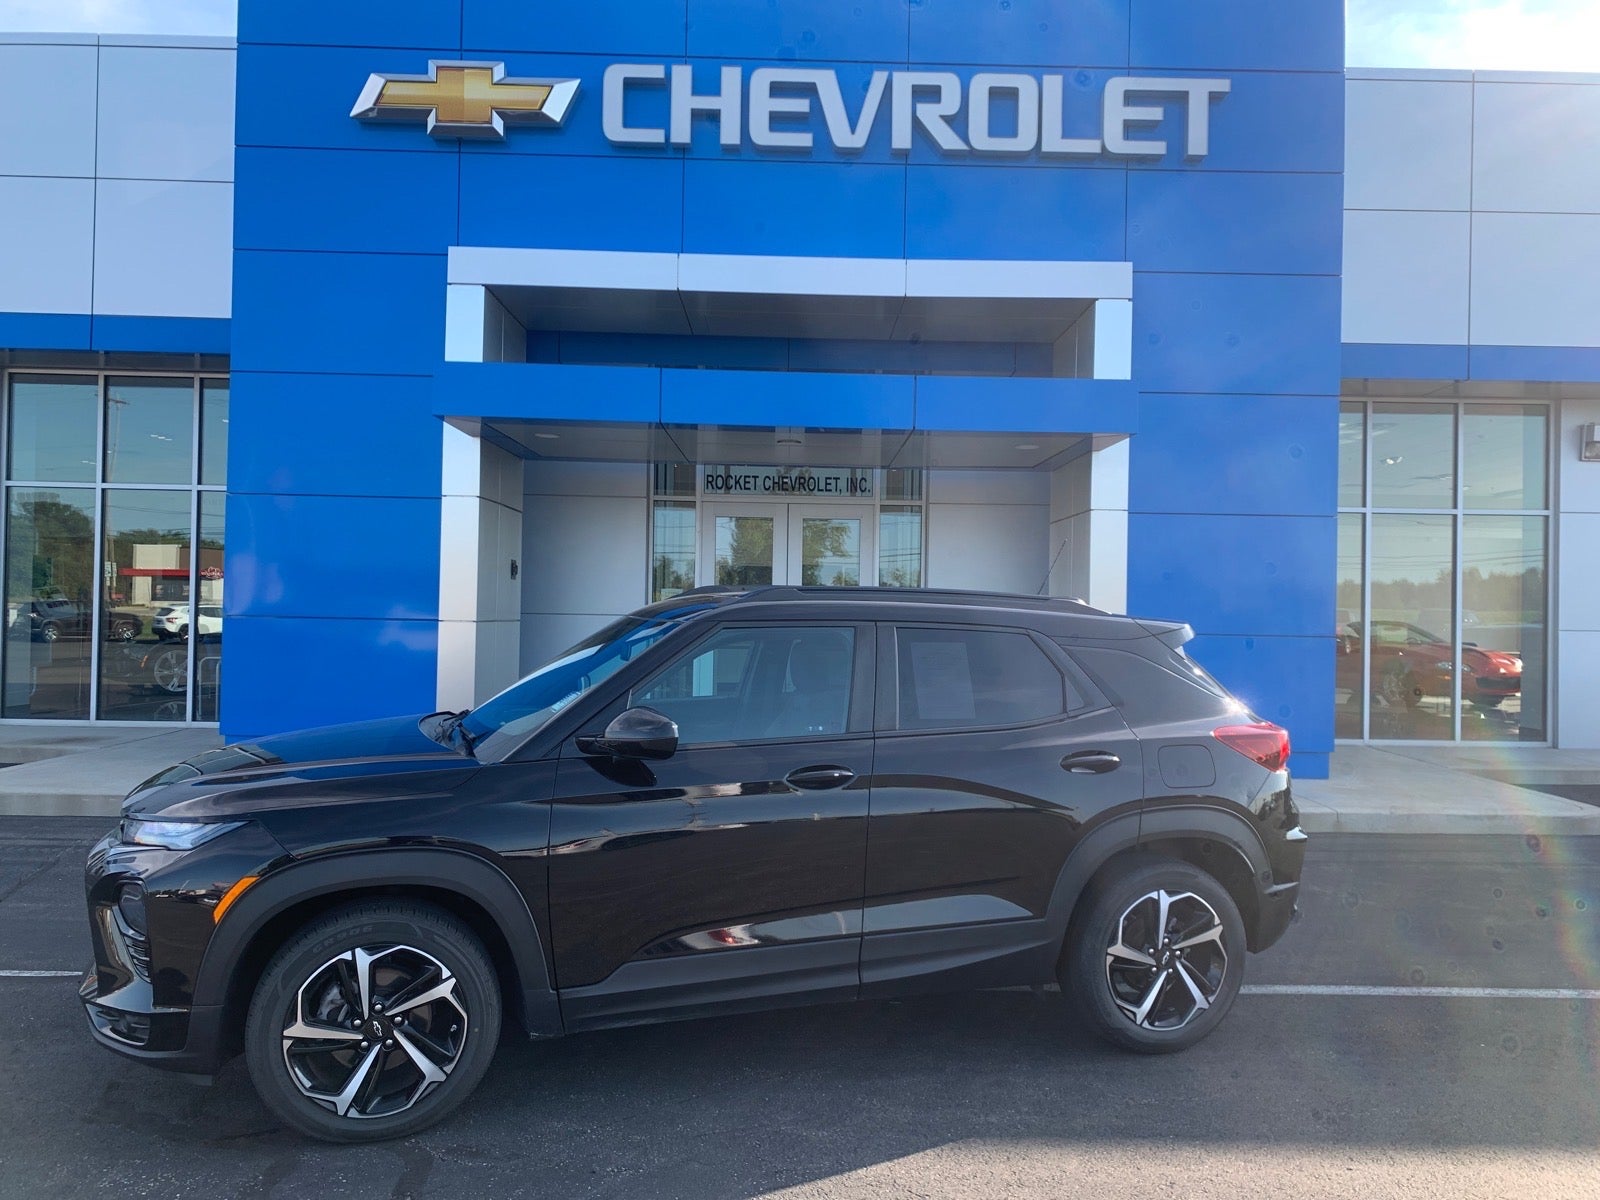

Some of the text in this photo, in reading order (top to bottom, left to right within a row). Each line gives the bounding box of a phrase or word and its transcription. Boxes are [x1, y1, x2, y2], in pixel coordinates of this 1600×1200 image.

[602, 63, 1232, 160] CHEVROLET
[705, 474, 871, 495] ROCKET CHEVROLET, INC.
